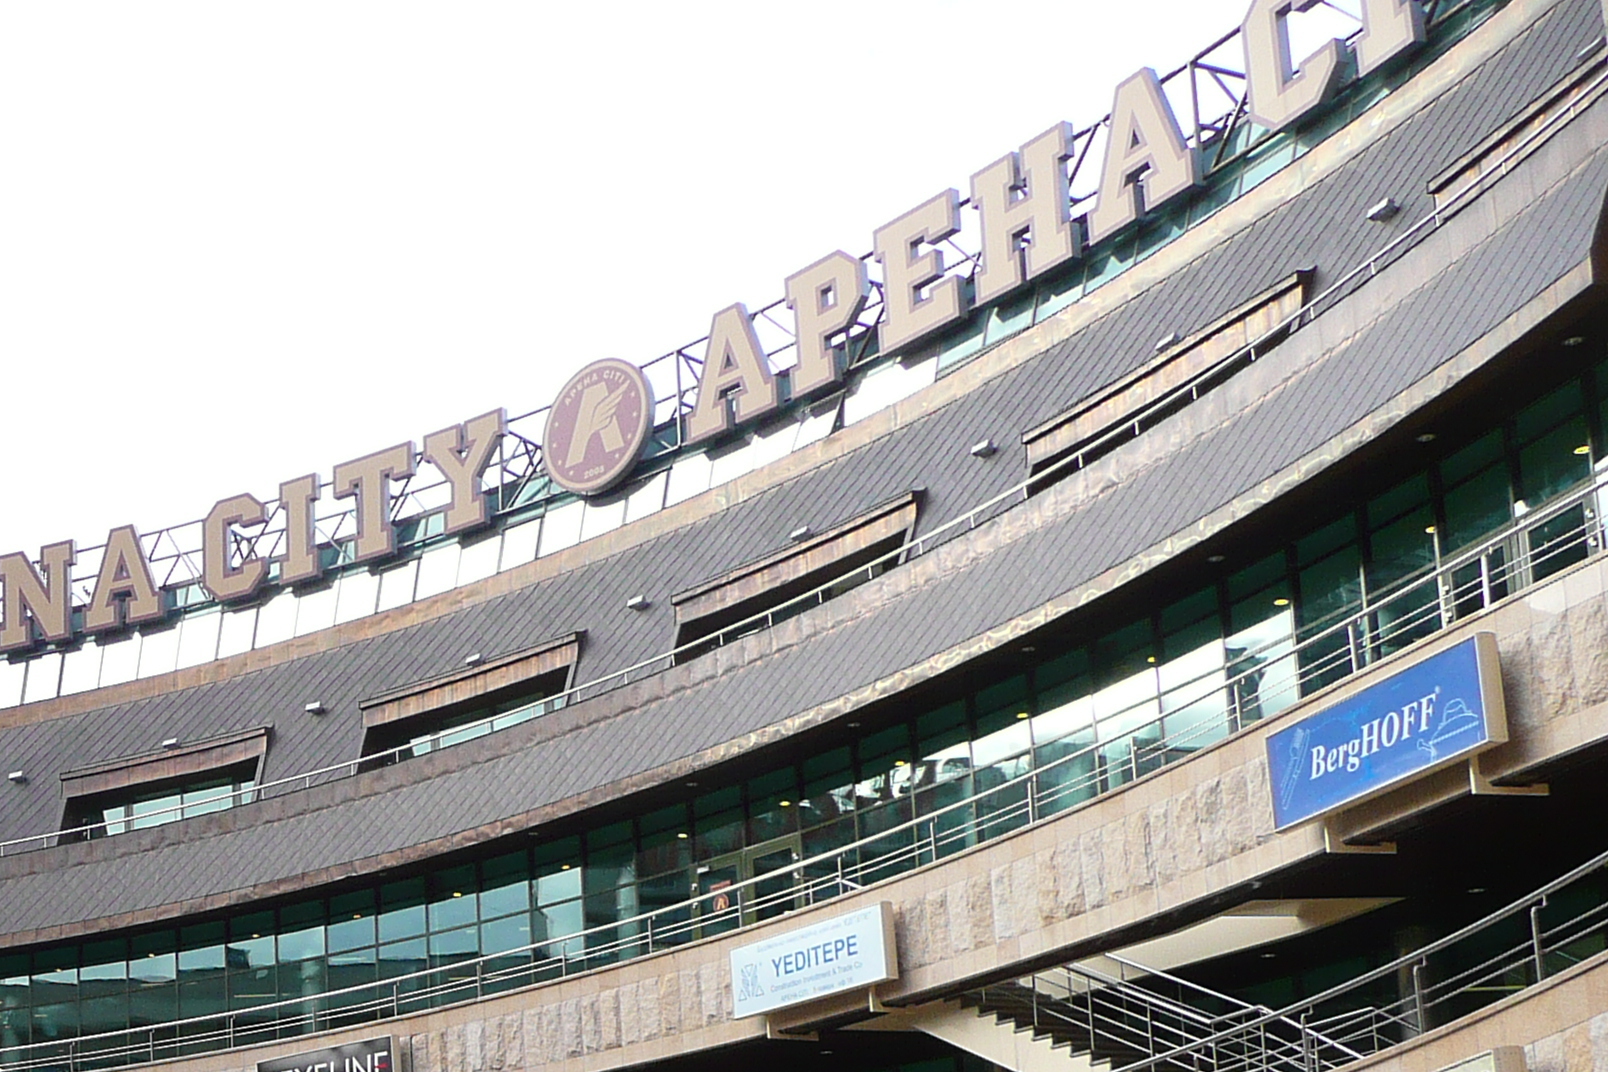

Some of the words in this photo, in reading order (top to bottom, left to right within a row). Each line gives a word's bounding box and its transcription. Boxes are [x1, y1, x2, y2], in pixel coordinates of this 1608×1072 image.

[686, 67, 1204, 444] АРЕНА
[202, 407, 508, 601] CITY
[1309, 693, 1437, 781] BergHOFF
[772, 934, 858, 978] YEDITEPE
